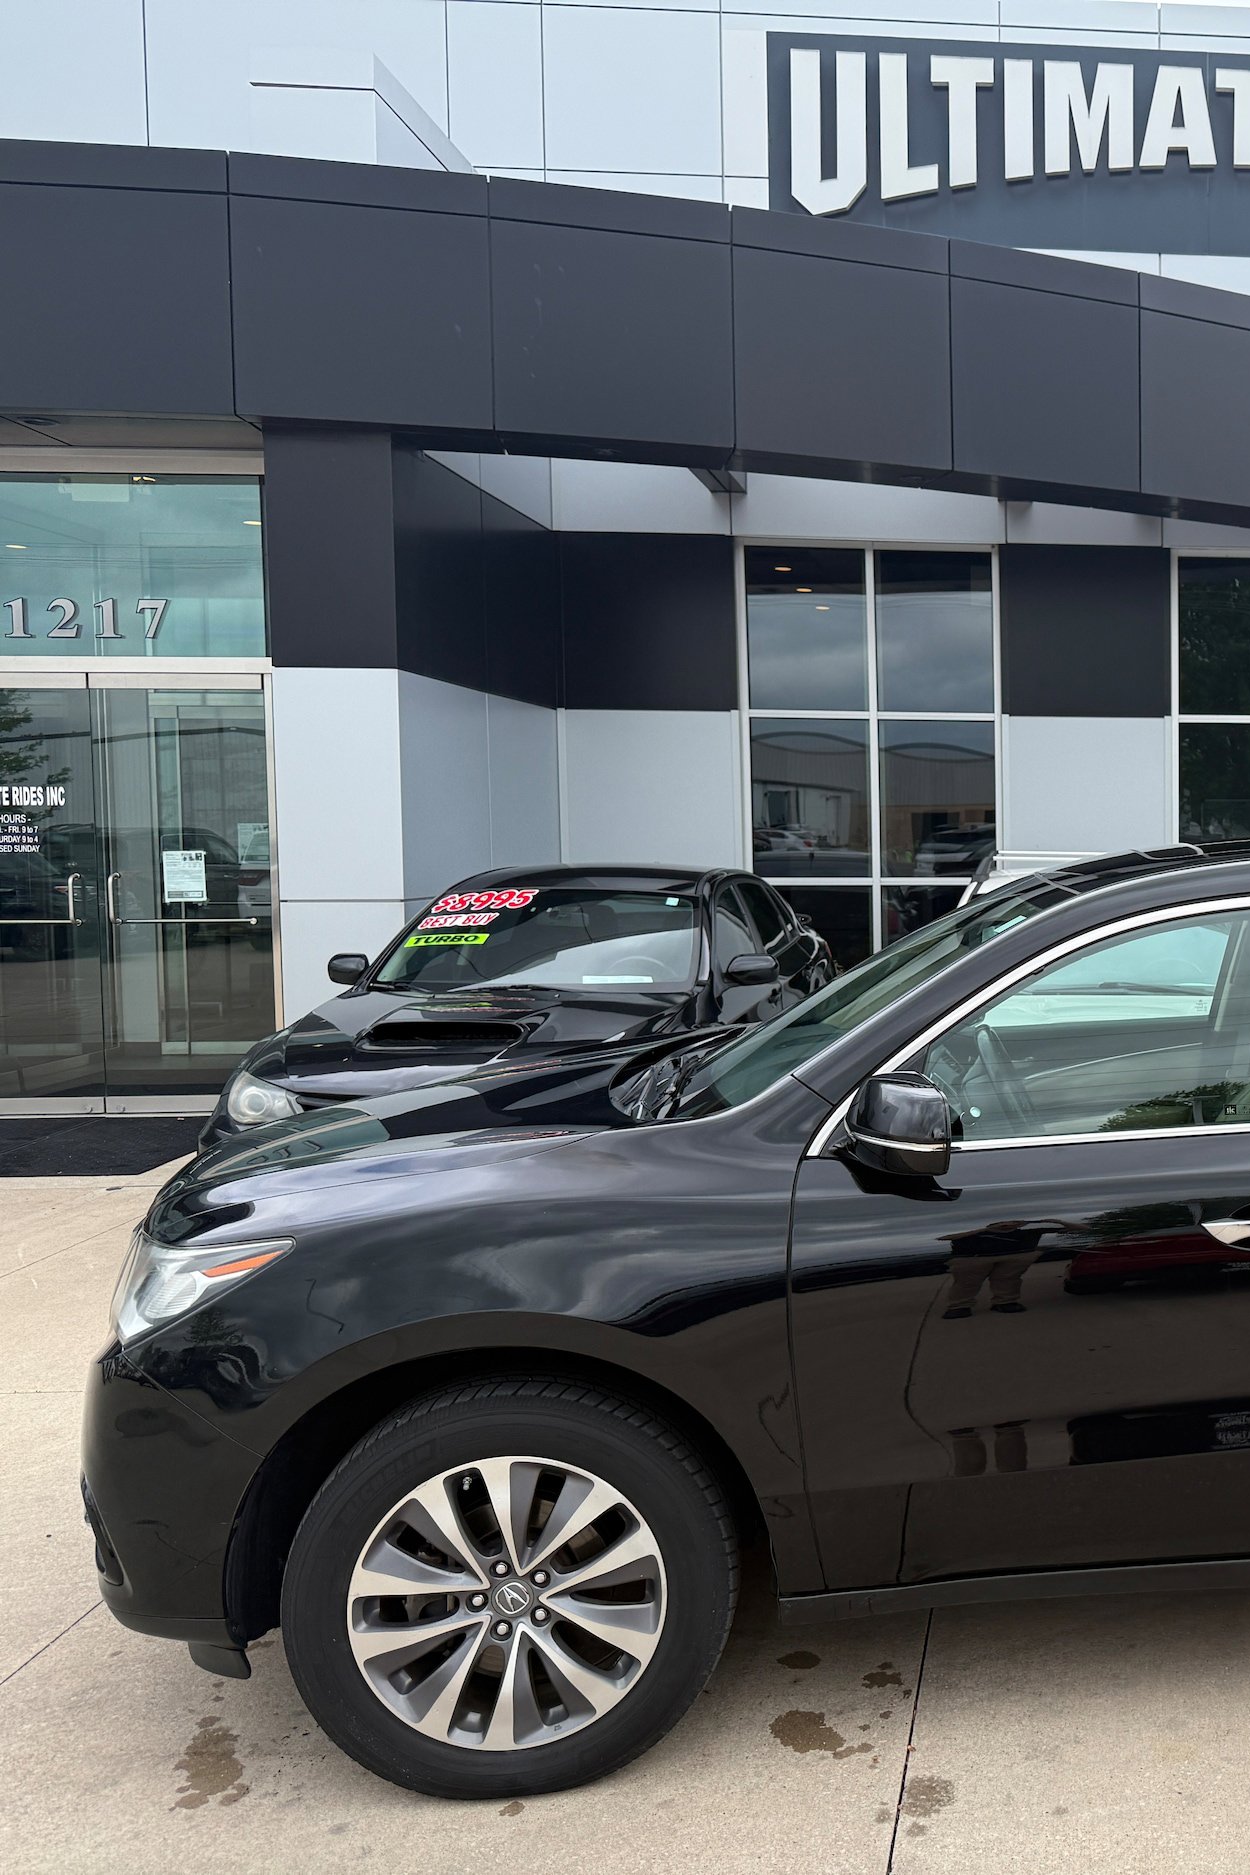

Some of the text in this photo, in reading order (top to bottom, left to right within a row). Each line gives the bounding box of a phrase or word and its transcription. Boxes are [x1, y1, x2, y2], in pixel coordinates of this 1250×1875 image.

[3, 597, 170, 639] 1217
[12, 786, 44, 806] RIDES
[46, 786, 65, 806] INC
[22, 835, 26, 843] 9
[27, 835, 33, 843] to
[34, 835, 39, 843] 4
[14, 845, 40, 853] SUNDAY
[431, 889, 539, 913] $8995
[418, 913, 500, 929] BEST BUY
[413, 935, 479, 945] TURBO
